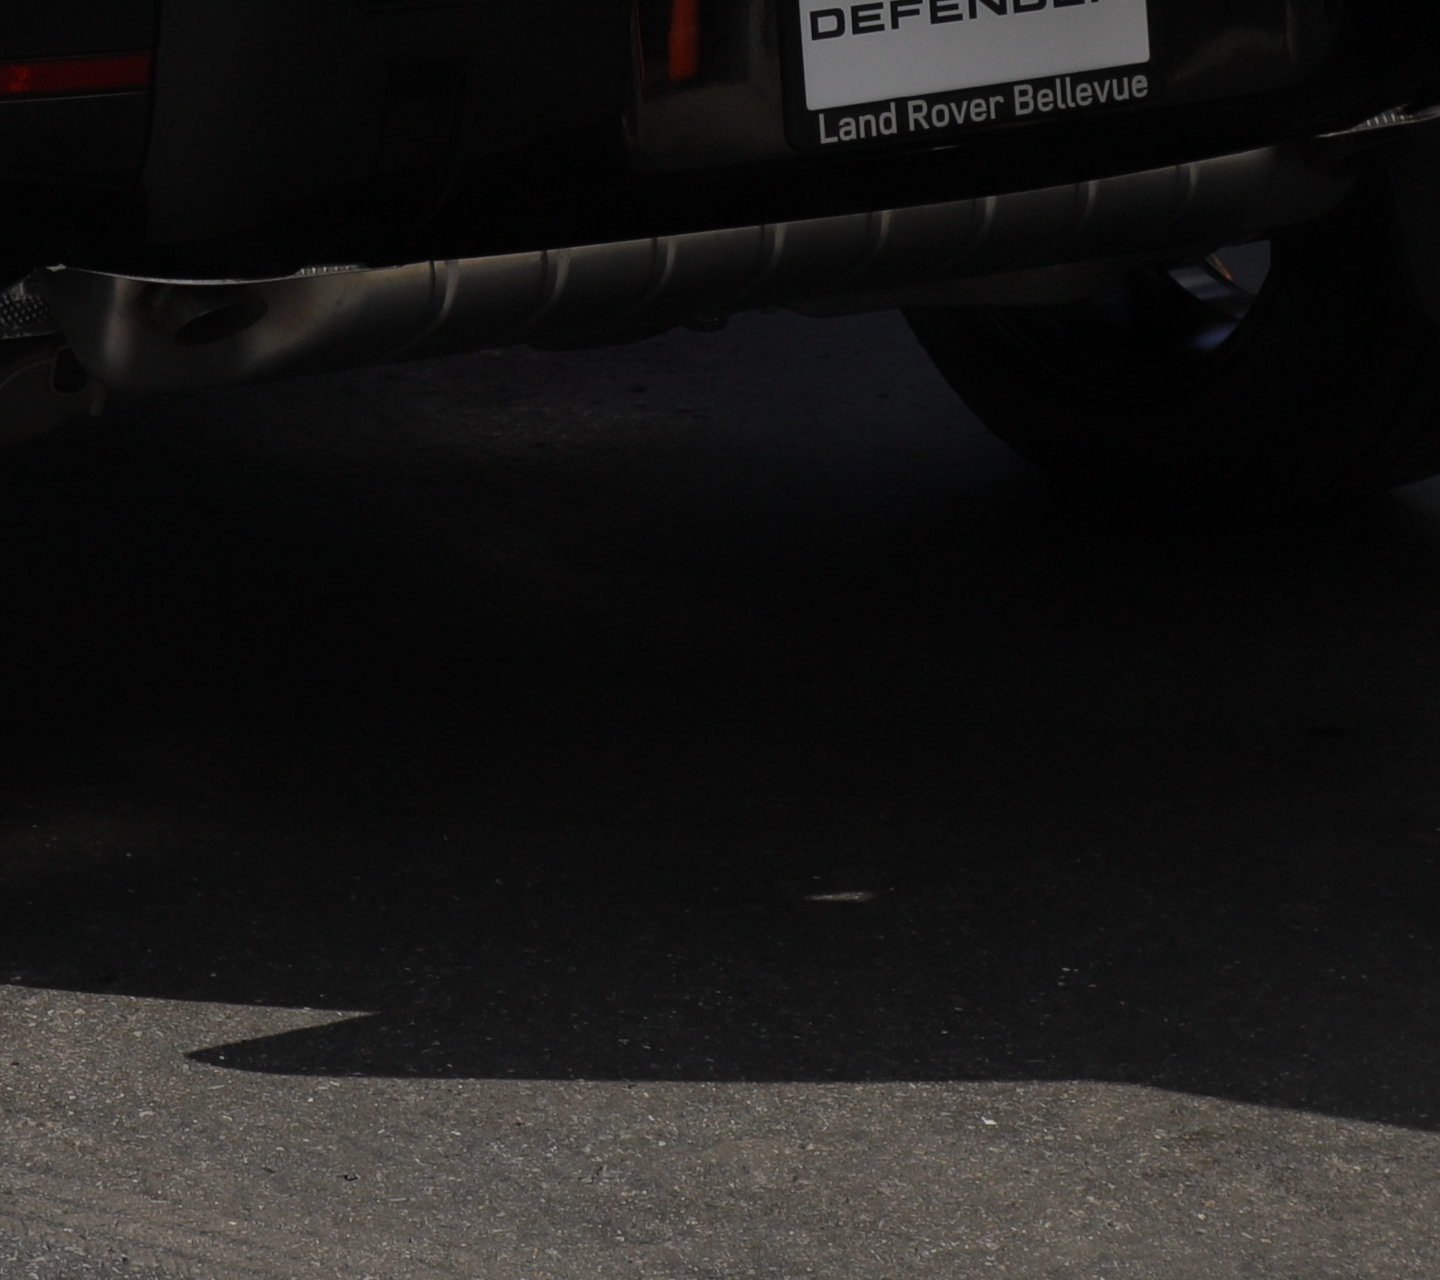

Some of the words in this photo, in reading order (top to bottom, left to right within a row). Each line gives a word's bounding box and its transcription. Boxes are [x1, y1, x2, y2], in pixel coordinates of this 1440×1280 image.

[818, 103, 898, 145] Land
[908, 92, 1005, 133] Rover
[1014, 71, 1149, 117] Bellevue
